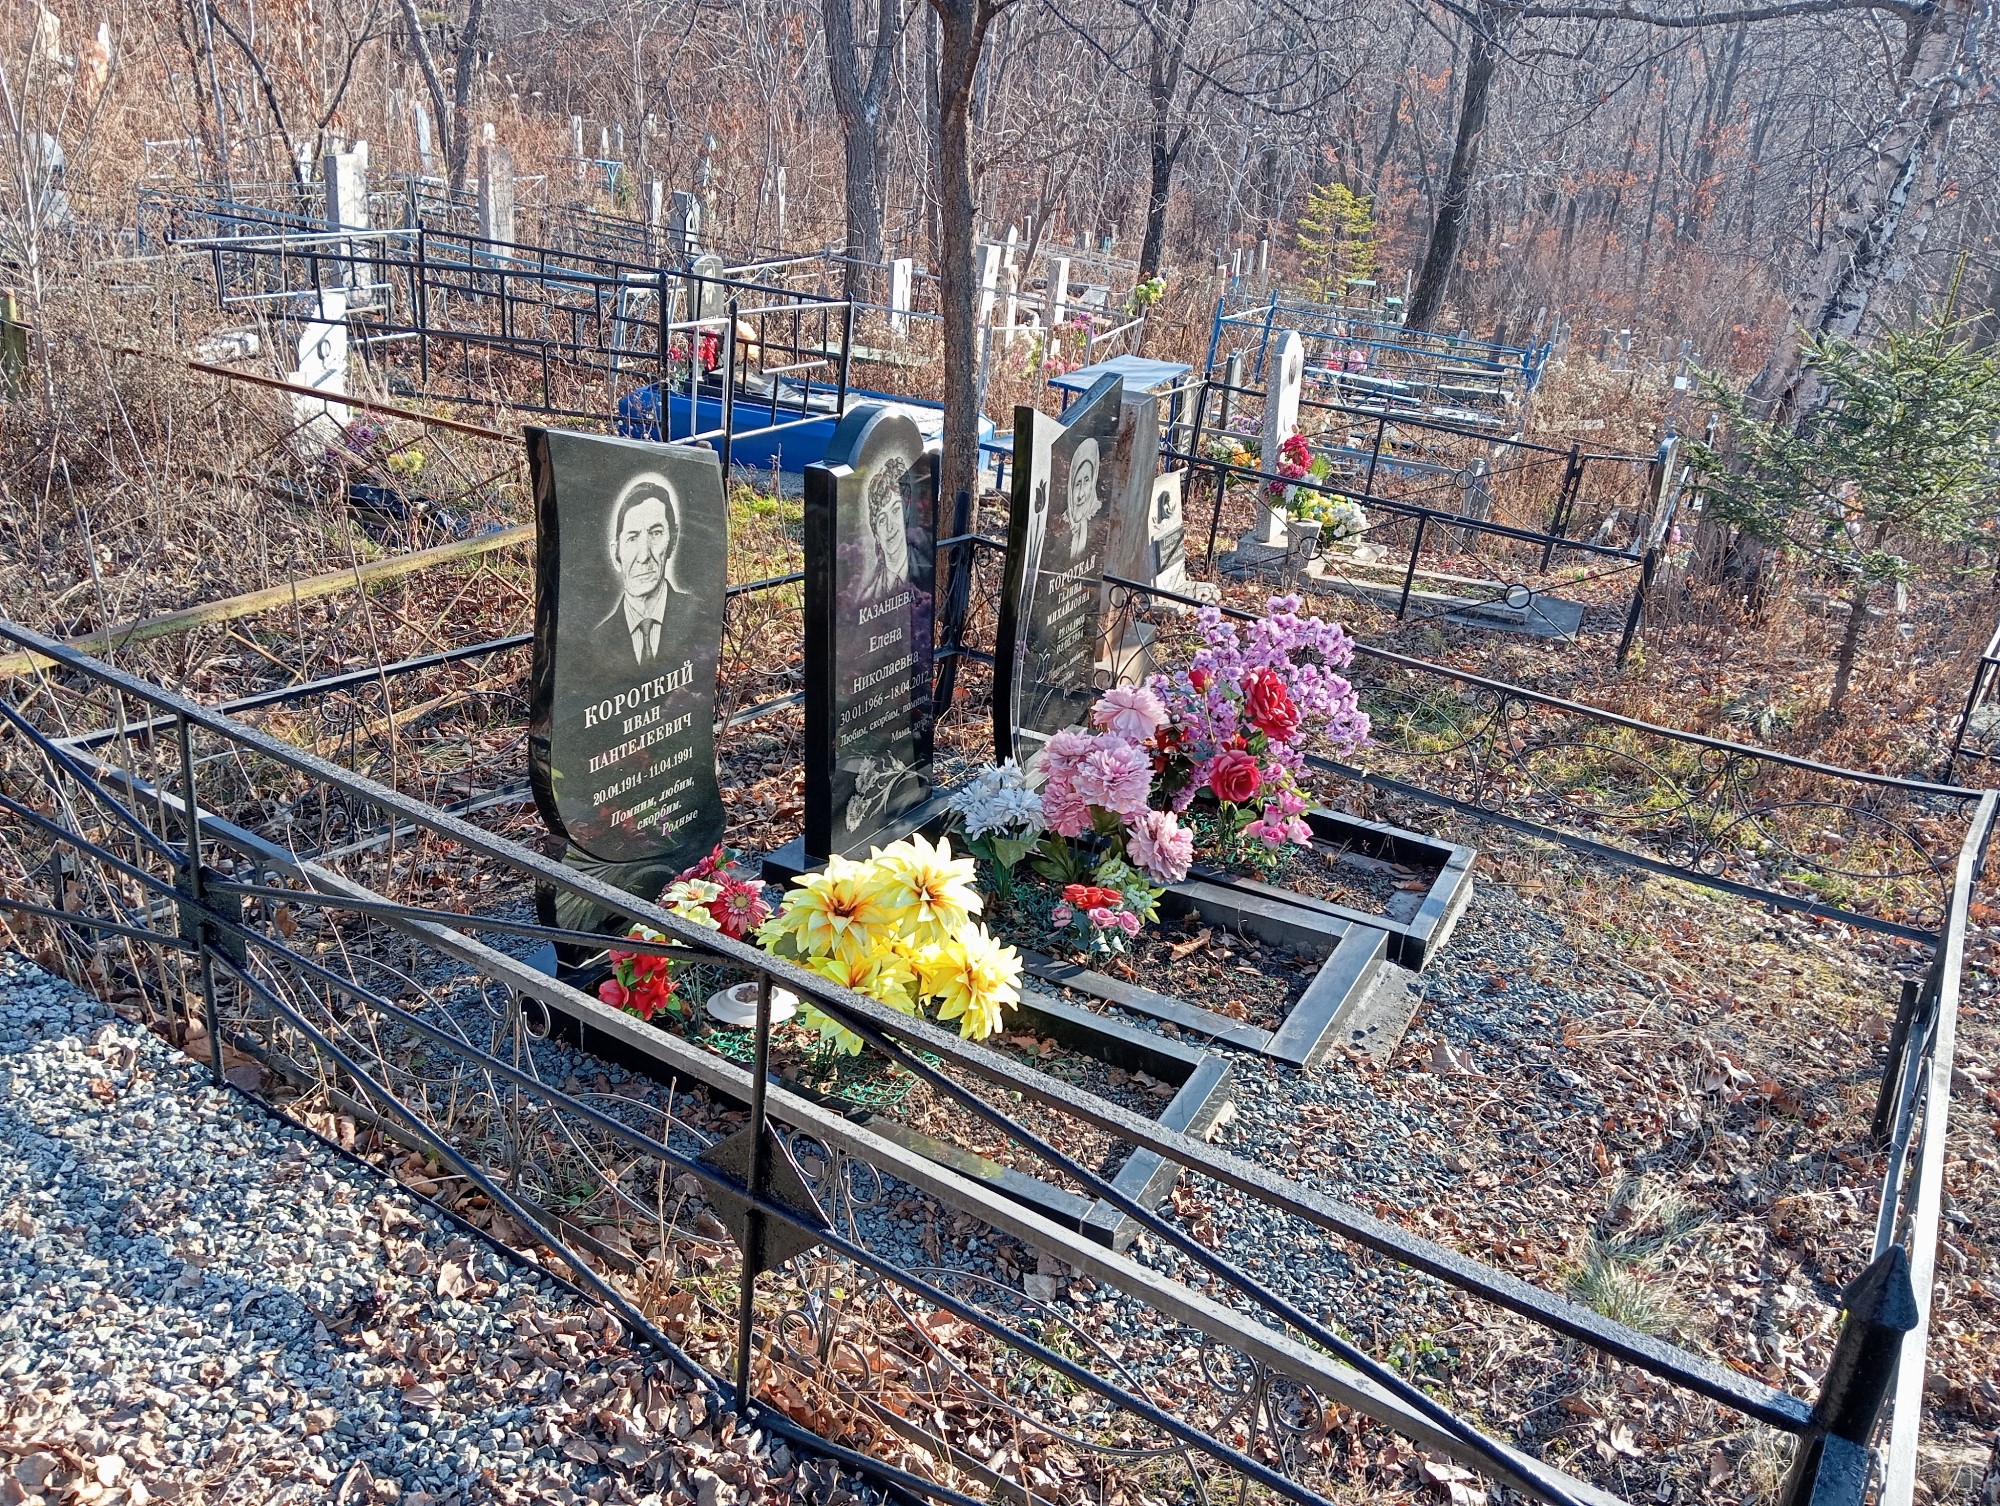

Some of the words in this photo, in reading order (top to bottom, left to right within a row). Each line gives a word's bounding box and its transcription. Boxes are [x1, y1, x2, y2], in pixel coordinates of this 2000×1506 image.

[1048, 555, 1097, 595] КОРОТКАЯ
[1058, 580, 1083, 604] ГАЛИНА
[858, 589, 916, 626] КАЗАНЦЕВА
[1046, 590, 1091, 626] МИХАЙЛОВНА
[869, 627, 902, 653] Елена
[853, 650, 919, 694] Николаевна
[584, 660, 693, 729] КОРОТКИЙ
[840, 693, 884, 727] 30.01.1966
[623, 705, 660, 735] ИВАН
[589, 712, 692, 773] ПАНТЕЛЕЕВИЧ
[650, 746, 694, 779] 11.04.1991
[610, 796, 657, 827] Помним,
[658, 776, 695, 802] любим,
[637, 800, 682, 830] скорбим.
[661, 809, 699, 836] Родные
